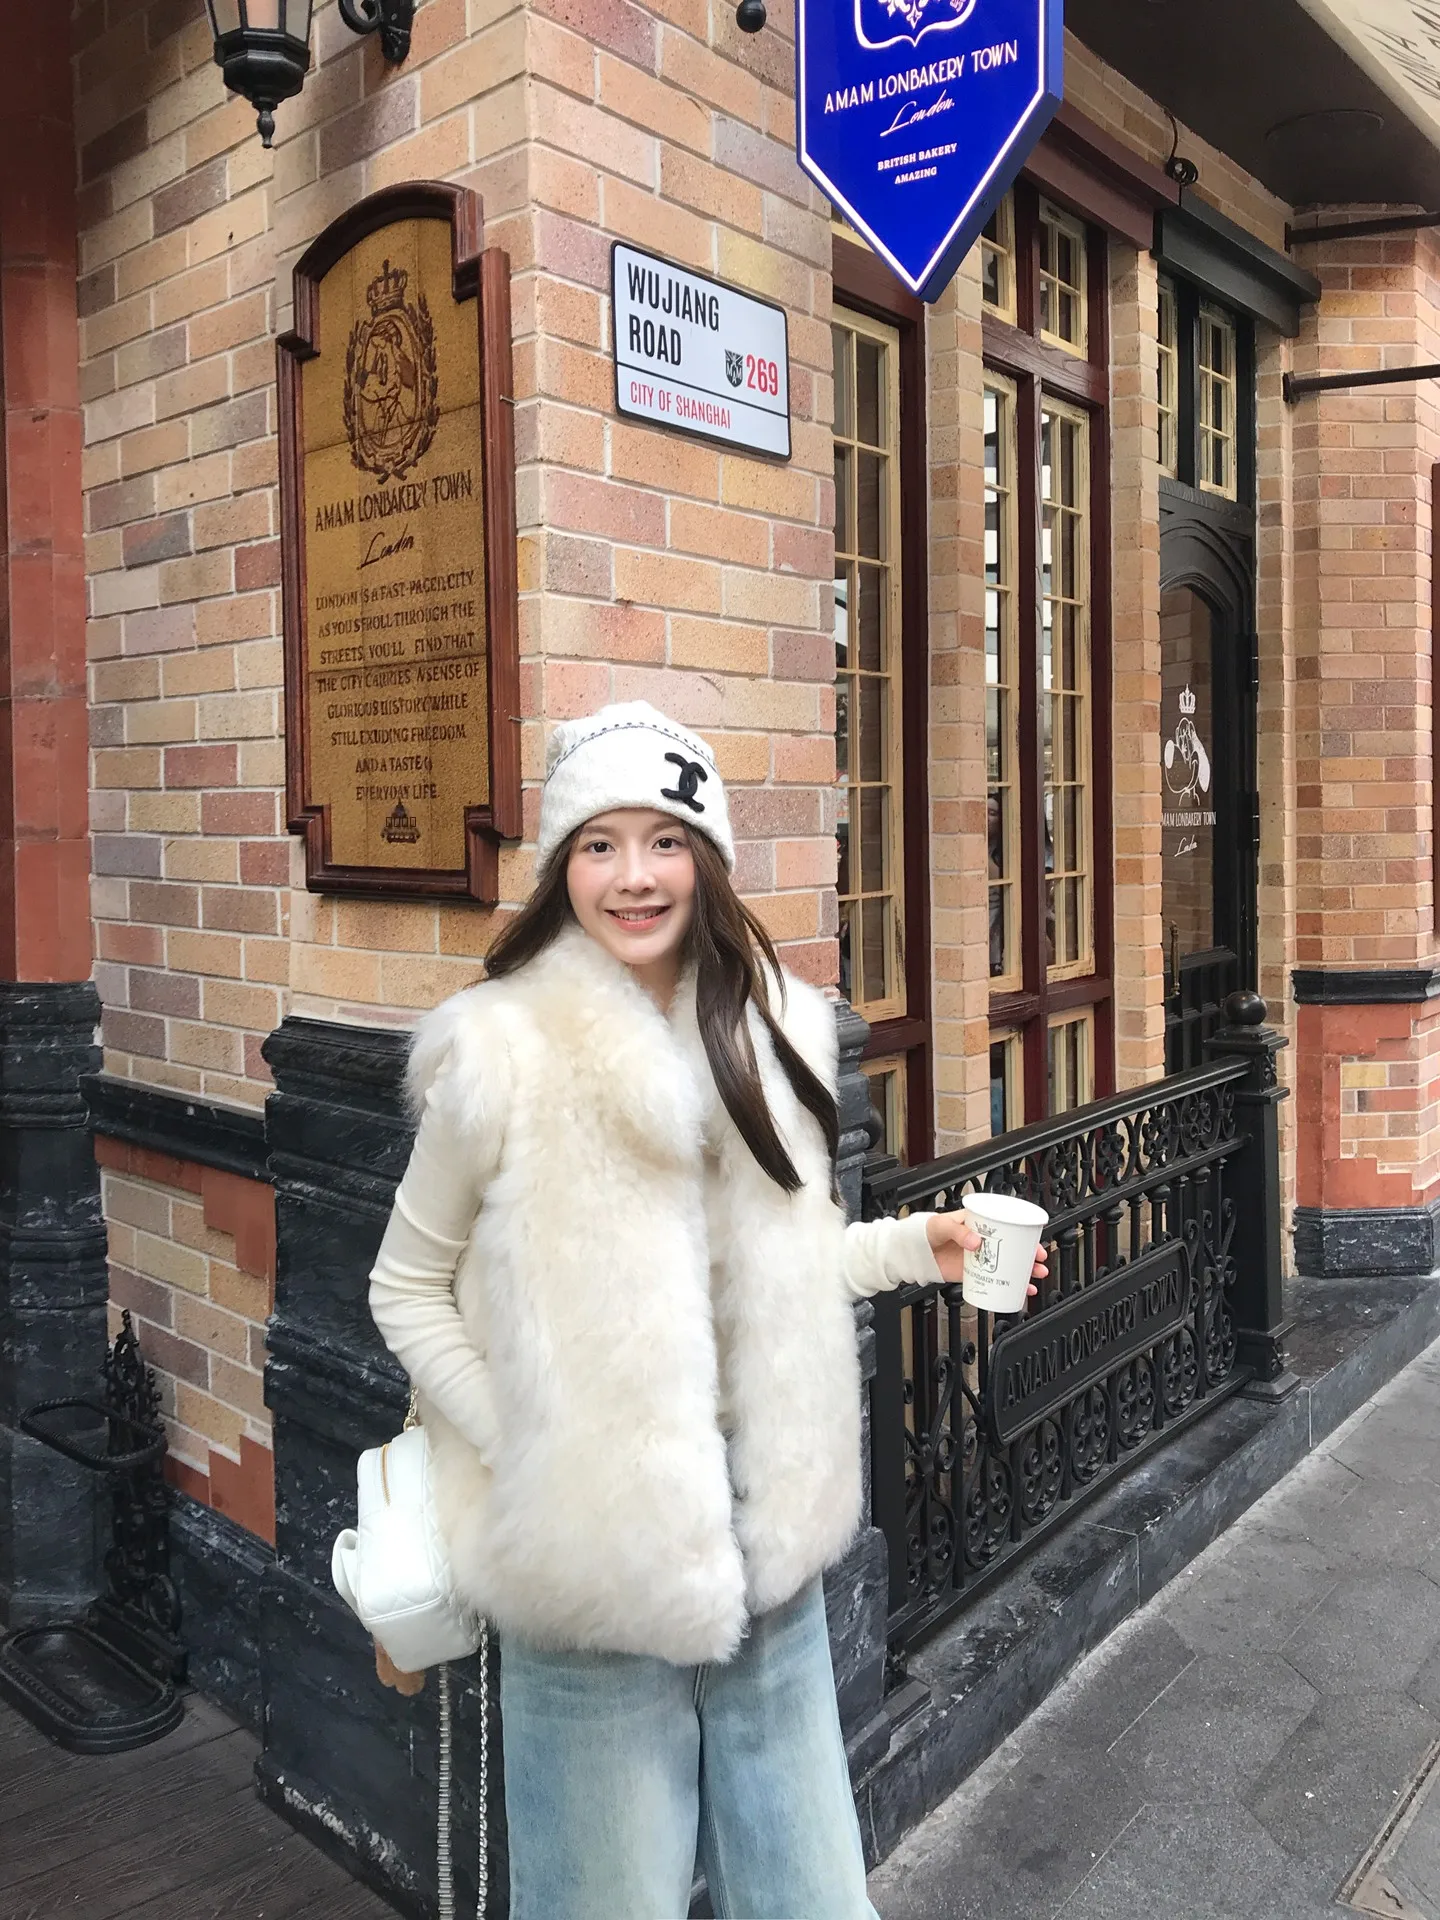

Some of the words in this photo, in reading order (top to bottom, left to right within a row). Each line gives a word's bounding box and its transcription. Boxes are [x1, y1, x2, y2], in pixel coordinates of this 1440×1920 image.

[824, 81, 874, 114] AMAM
[879, 54, 965, 99] LONBAKERY
[971, 39, 1018, 73] TOWN
[877, 152, 917, 171] BRITISH
[918, 143, 957, 161] BAKERY
[894, 166, 938, 185] AMAZING
[627, 262, 719, 332] WUJIANG
[629, 313, 682, 366] ROAD
[746, 354, 778, 396] 269
[630, 381, 654, 408] CITY
[658, 389, 672, 412] OF
[676, 394, 731, 429] SHANGHAI
[315, 499, 355, 532] AMAM
[432, 470, 473, 504] TOWN
[316, 590, 358, 610] LONDON
[447, 569, 475, 590] CITY
[319, 622, 331, 638] AS
[332, 620, 352, 637] YOU
[450, 601, 475, 619] THE
[415, 636, 442, 654] FIND
[443, 632, 475, 649] THAT
[317, 677, 337, 694] THE
[426, 663, 462, 682] SENSE
[464, 661, 480, 678] OF
[328, 700, 379, 719] GLORIOUS
[331, 731, 359, 746] STILL
[360, 727, 409, 746] EXUDING
[411, 724, 466, 742] FREEDOM
[356, 757, 378, 773] AND
[380, 757, 387, 772] A
[389, 755, 422, 772] TASTE
[356, 784, 410, 800] EVERYDAY
[1203, 811, 1217, 826] TOWN
[1003, 1338, 1058, 1411] AMAM
[1061, 1291, 1138, 1374] LONBAKERY
[1141, 1269, 1179, 1322] TOWN
